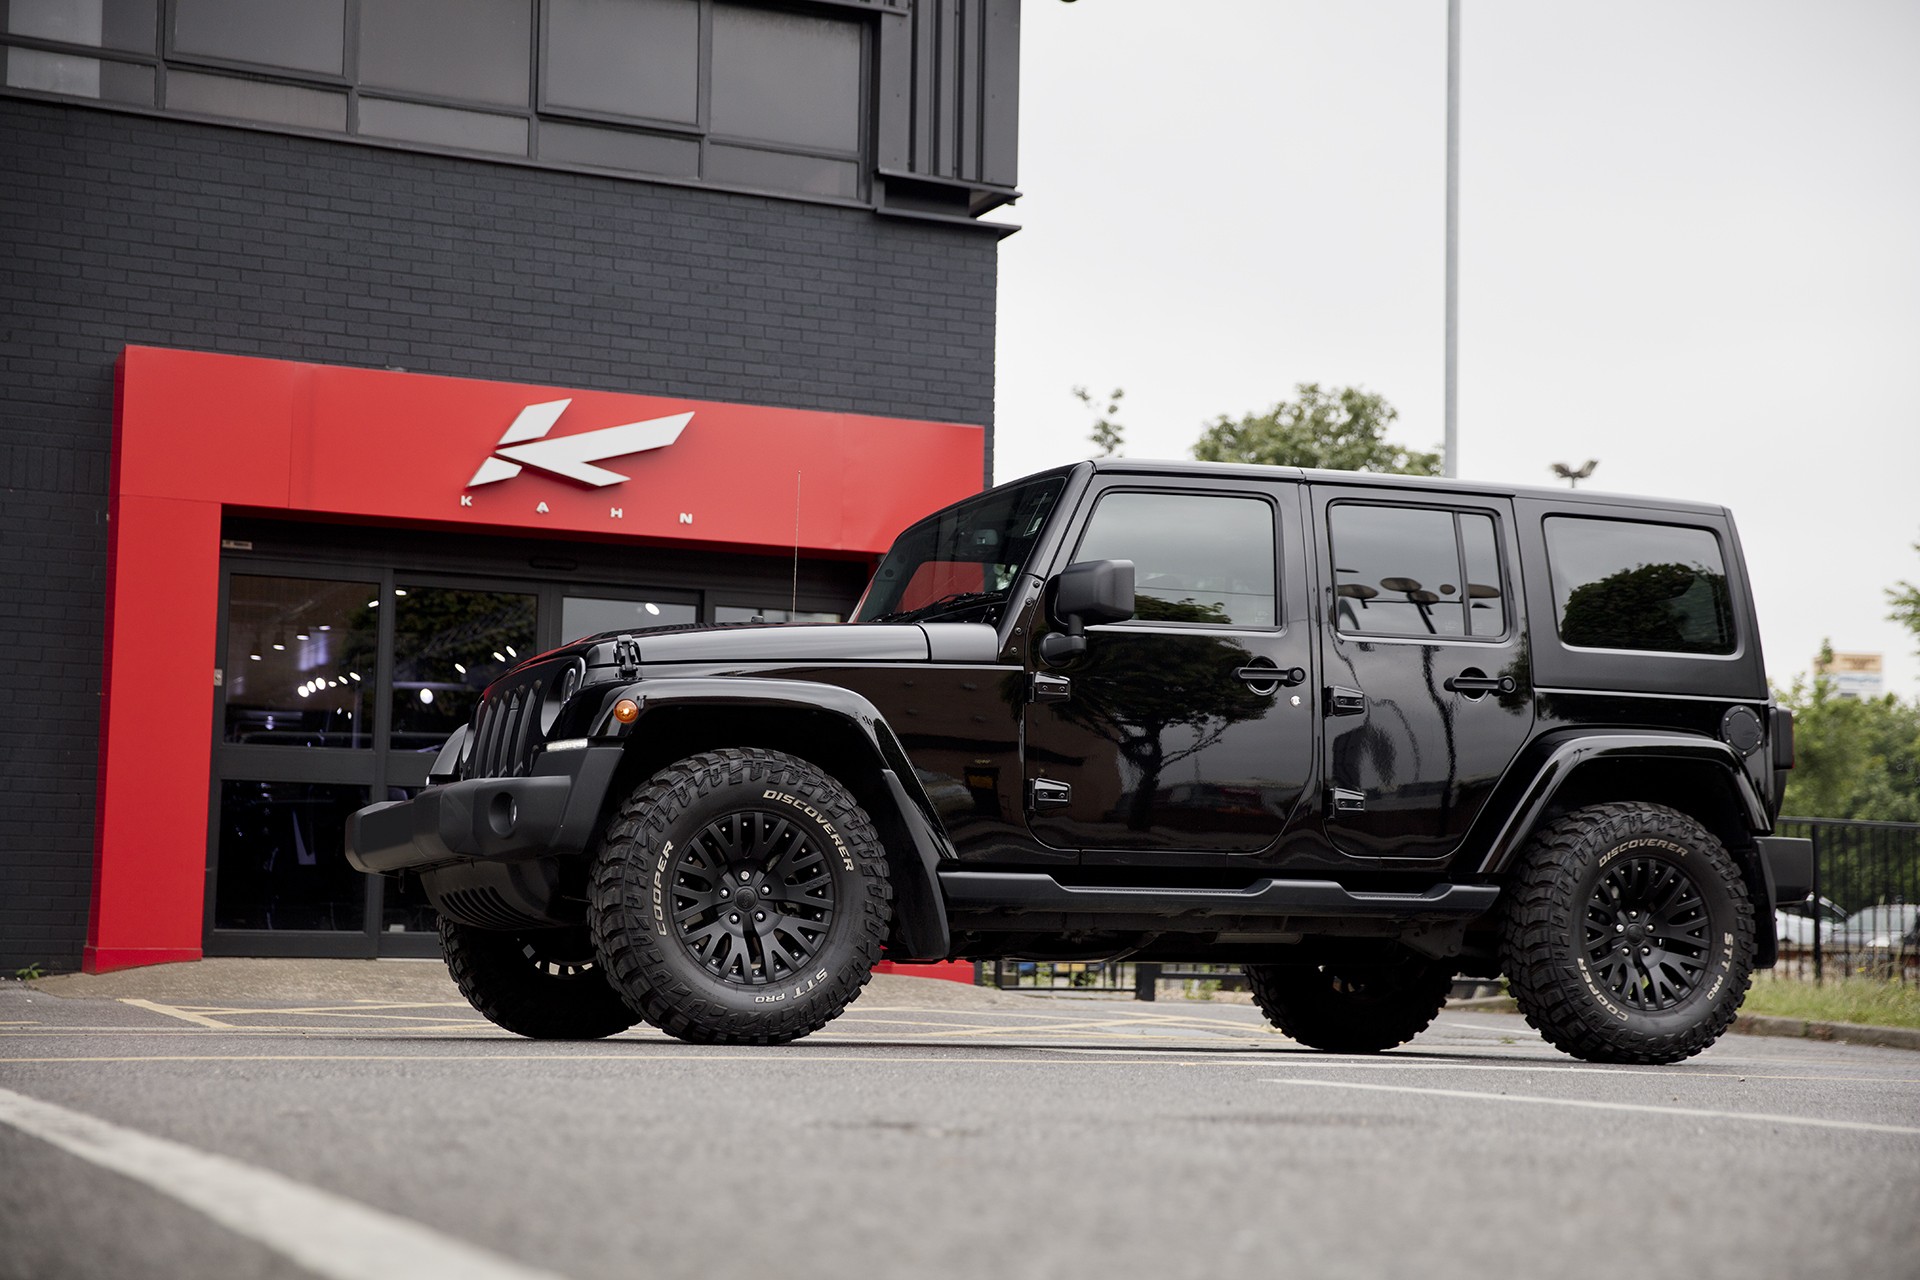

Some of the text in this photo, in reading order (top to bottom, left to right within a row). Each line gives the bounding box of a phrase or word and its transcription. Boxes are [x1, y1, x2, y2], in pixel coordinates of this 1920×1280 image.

[460, 495, 693, 524] KAHN
[763, 789, 854, 871] DISCOVERER
[1599, 838, 1688, 867] DISCOVERER
[649, 840, 674, 936] COOPER
[754, 967, 828, 1003] STT PRO
[1577, 957, 1629, 1022] COOPER
[1706, 932, 1734, 1001] STT PRO
